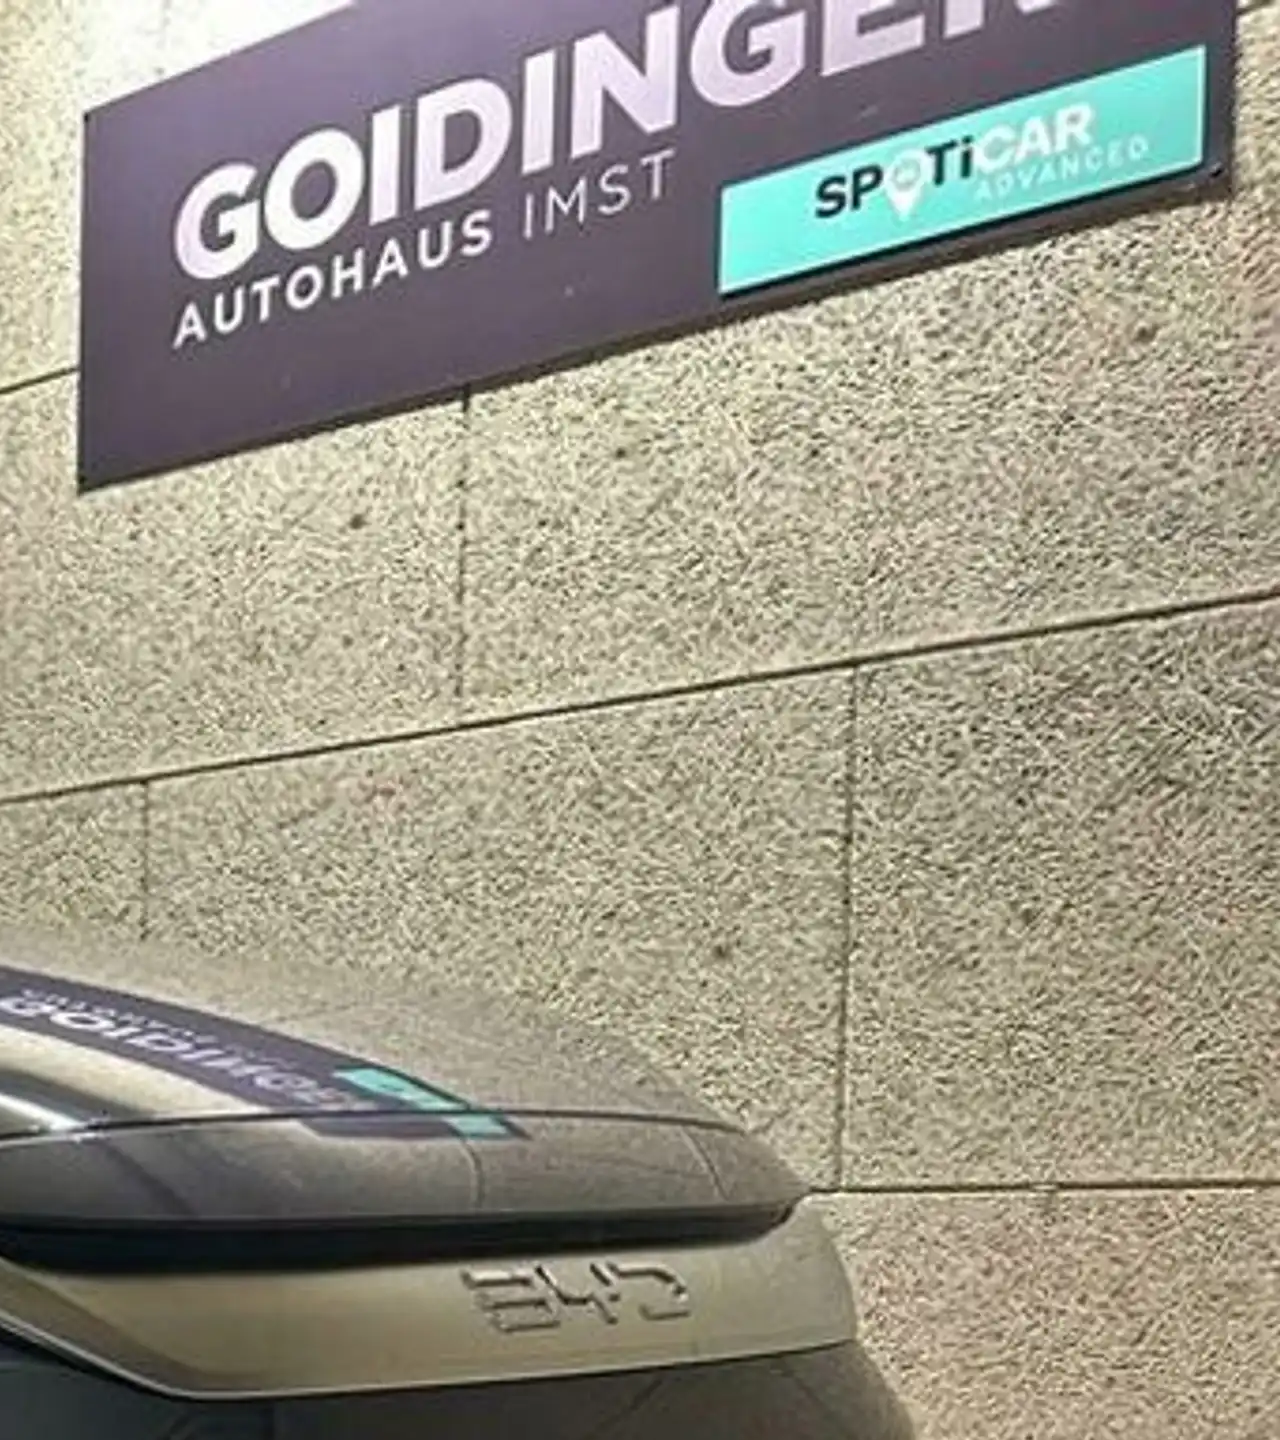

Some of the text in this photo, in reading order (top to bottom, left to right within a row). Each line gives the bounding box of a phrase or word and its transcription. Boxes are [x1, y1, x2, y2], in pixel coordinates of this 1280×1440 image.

[974, 135, 1150, 203] ADVANCED
[172, 149, 676, 349] AUTOHAUS IMST
[459, 1261, 691, 1333] BYD
